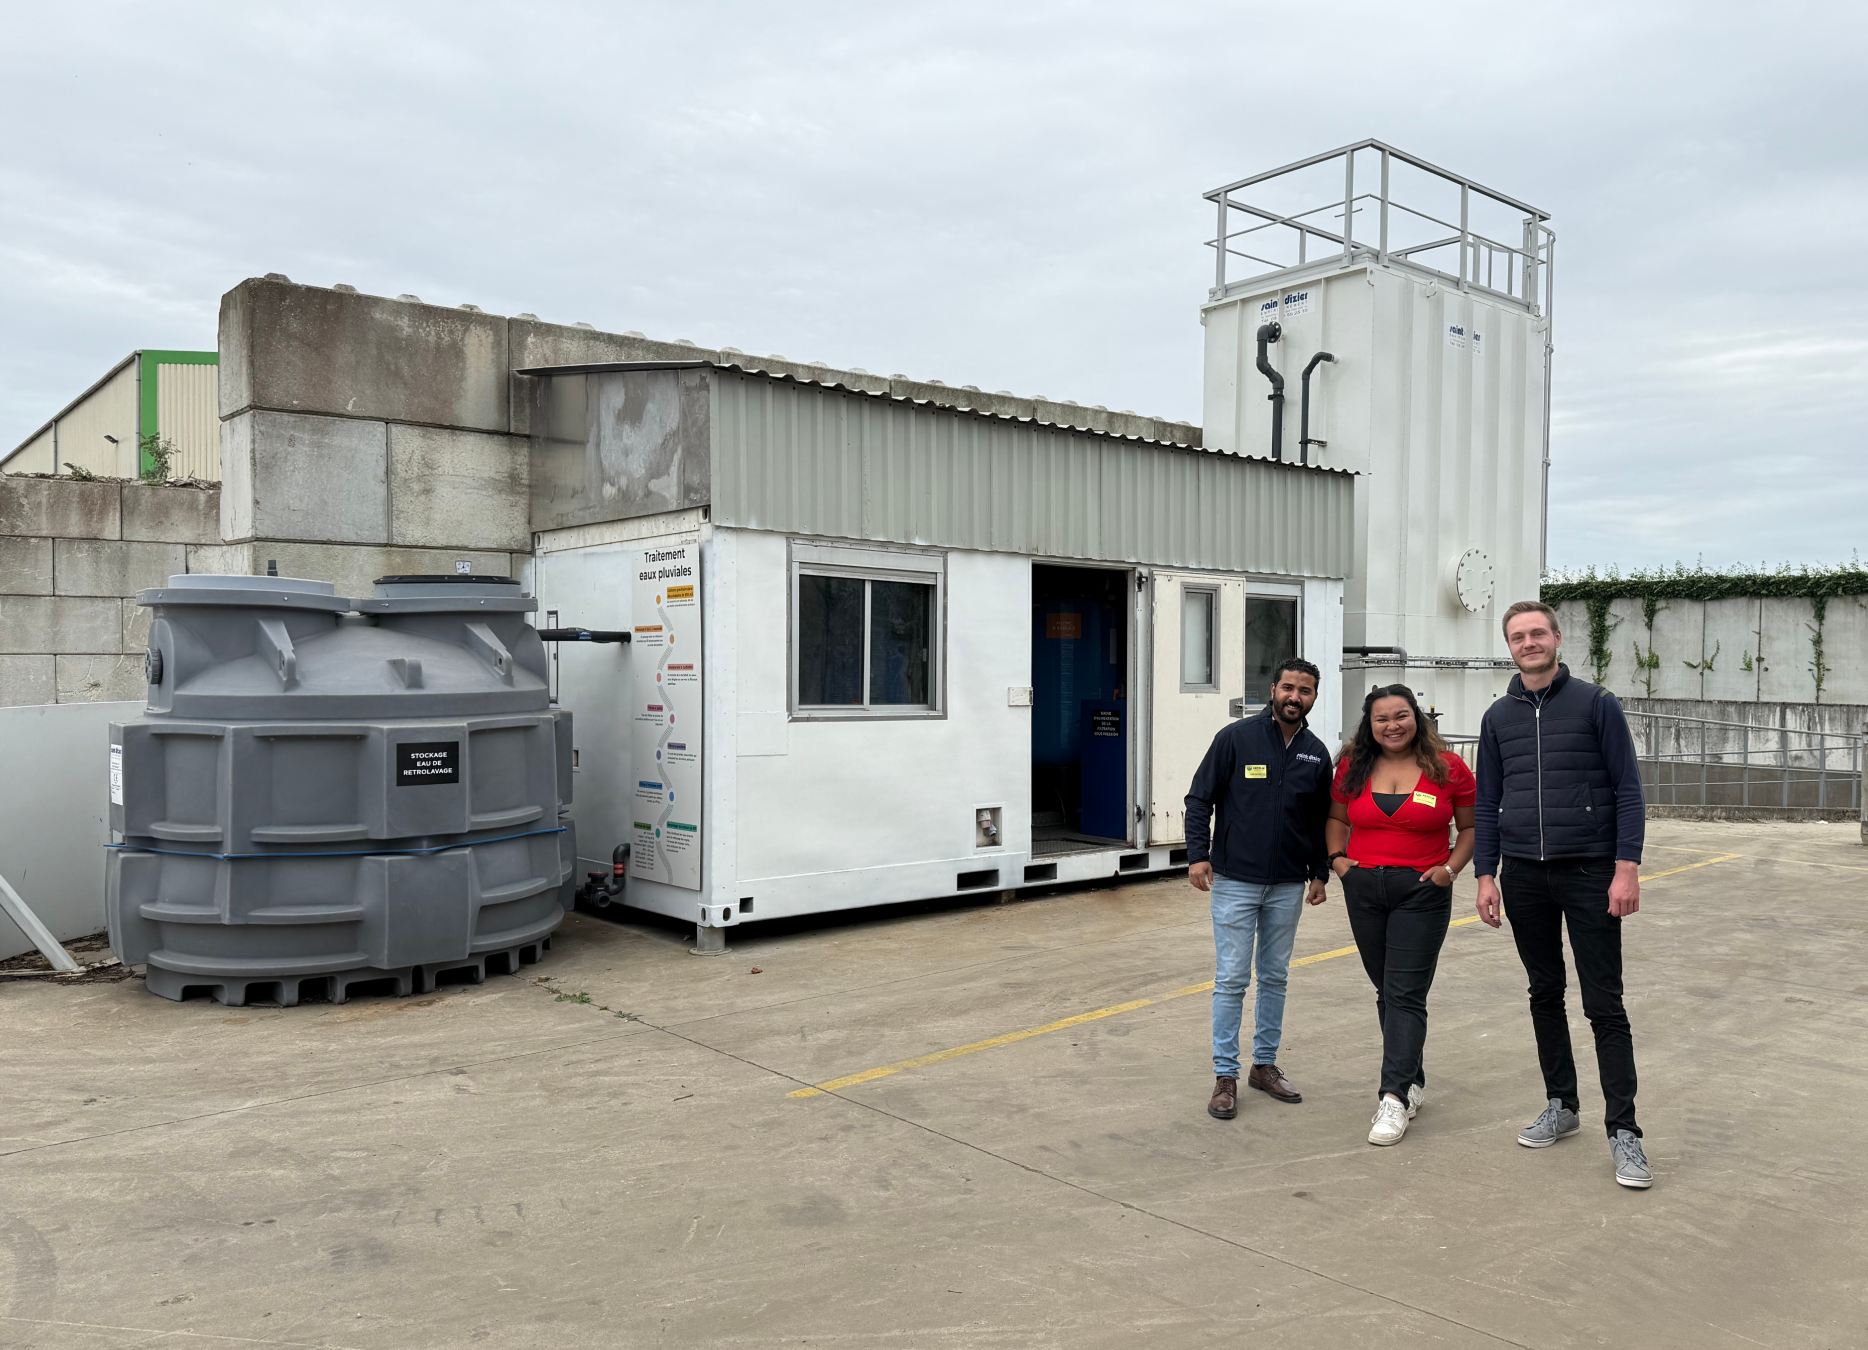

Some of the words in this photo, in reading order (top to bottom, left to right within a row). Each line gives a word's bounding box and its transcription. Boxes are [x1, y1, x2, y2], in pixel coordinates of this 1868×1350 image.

[1285, 292, 1308, 305] dizier
[644, 548, 686, 564] Traitement
[639, 571, 657, 581] eaux
[658, 565, 692, 582] pluviales
[403, 768, 453, 776] RETROLAVAGE
